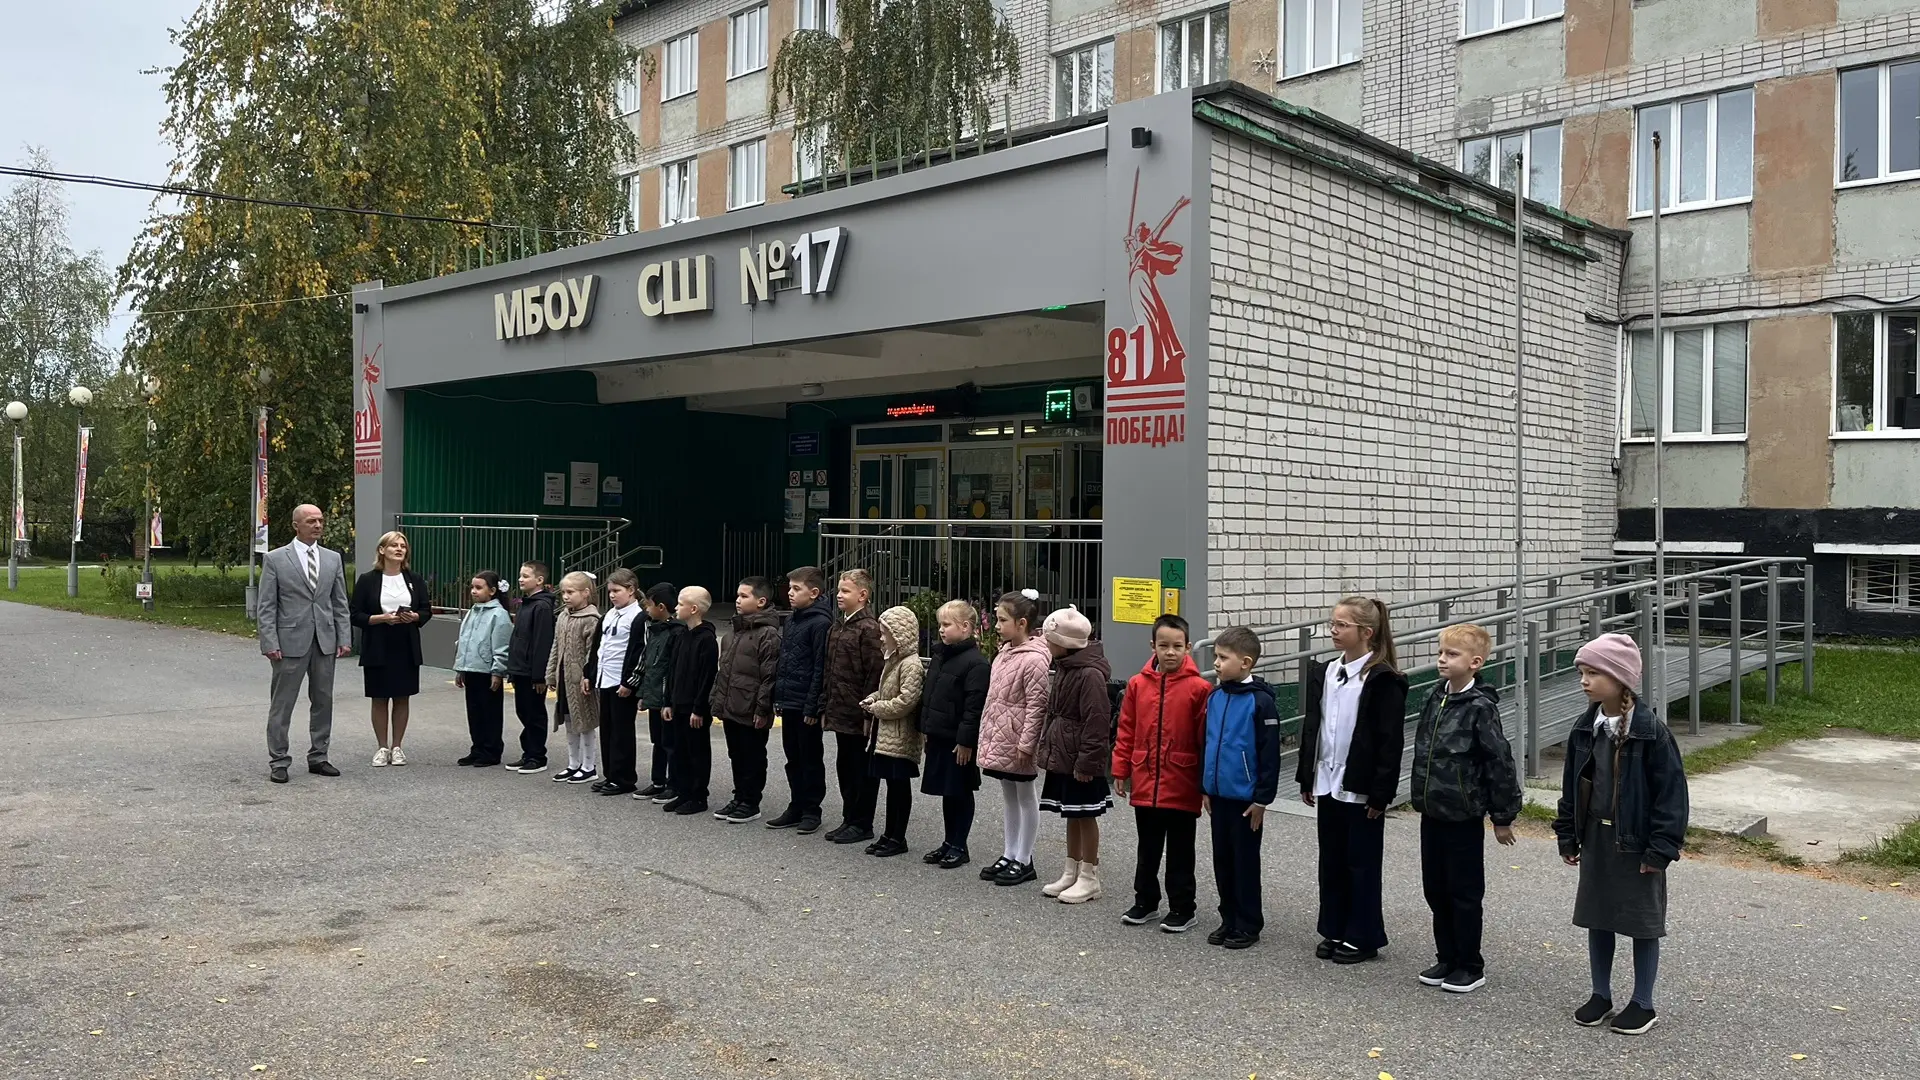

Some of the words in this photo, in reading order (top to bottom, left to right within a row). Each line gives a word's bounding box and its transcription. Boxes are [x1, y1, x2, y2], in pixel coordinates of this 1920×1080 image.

[494, 274, 598, 340] МБОУ
[637, 254, 714, 317] СШ
[1107, 325, 1145, 382] 81
[355, 409, 367, 440] 81
[1107, 414, 1185, 448] ПОБЕДА!
[355, 458, 382, 476] ПОБЕДА!
